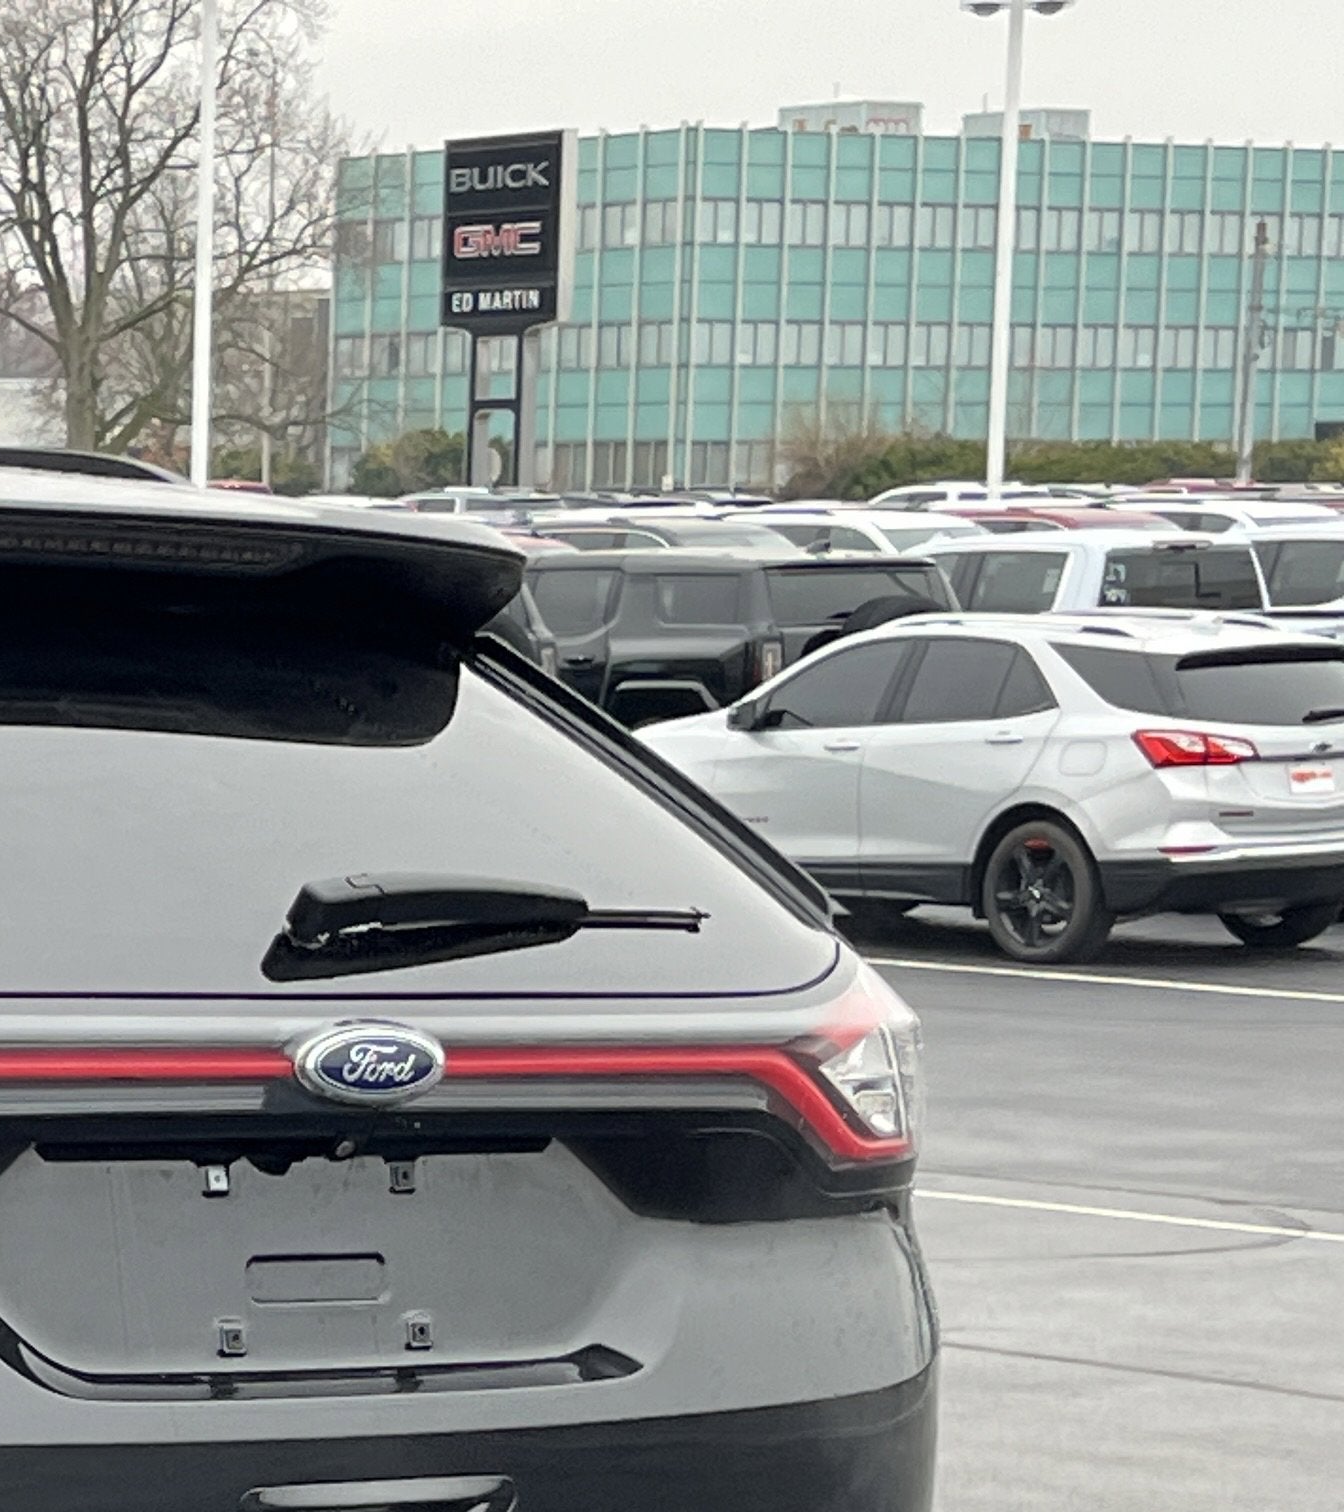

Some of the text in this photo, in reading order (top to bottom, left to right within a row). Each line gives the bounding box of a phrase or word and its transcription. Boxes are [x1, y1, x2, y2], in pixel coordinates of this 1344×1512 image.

[449, 161, 549, 192] BUICK
[454, 221, 542, 258] GMC
[452, 289, 540, 312] ED MARTIN
[342, 1043, 416, 1082] Ford
